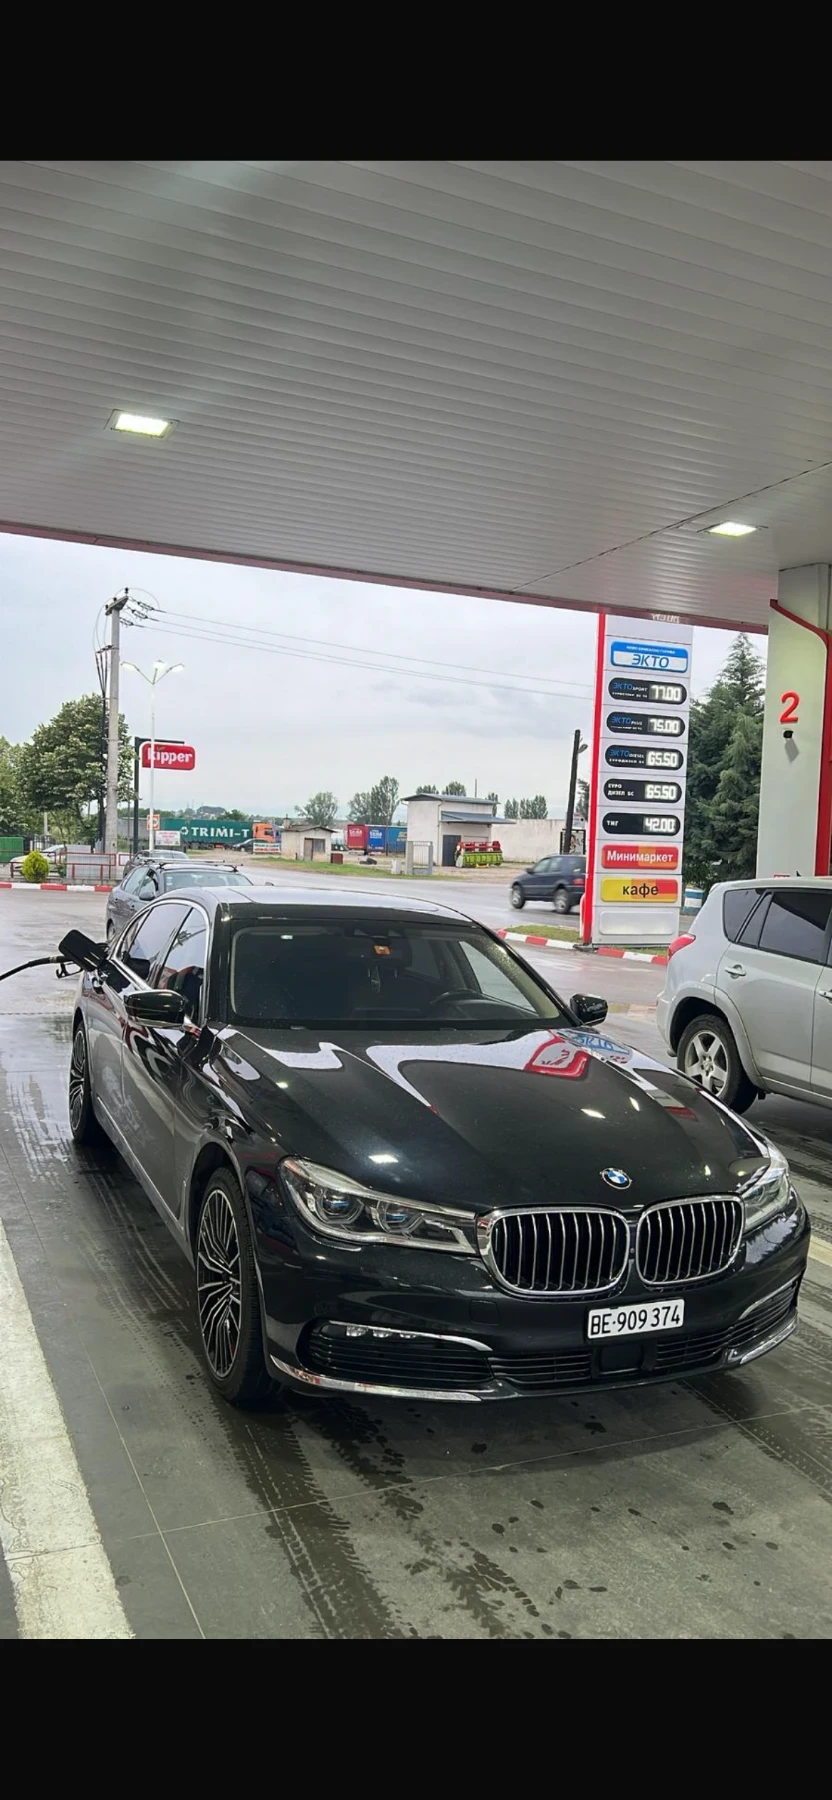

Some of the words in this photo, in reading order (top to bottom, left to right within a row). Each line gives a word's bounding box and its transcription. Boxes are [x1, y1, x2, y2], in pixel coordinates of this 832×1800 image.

[631, 653, 669, 668] ЭКТО
[651, 684, 682, 702] 77.00
[780, 692, 800, 724] 2
[649, 717, 680, 734] 75.00
[647, 750, 679, 768] 65.50
[646, 783, 677, 800] 65.50
[191, 826, 250, 838] TRIMI-T
[645, 816, 676, 833] 42.00
[606, 849, 674, 865] Минимаркет
[622, 883, 659, 898] кафе
[650, 1304, 681, 1328] 374
